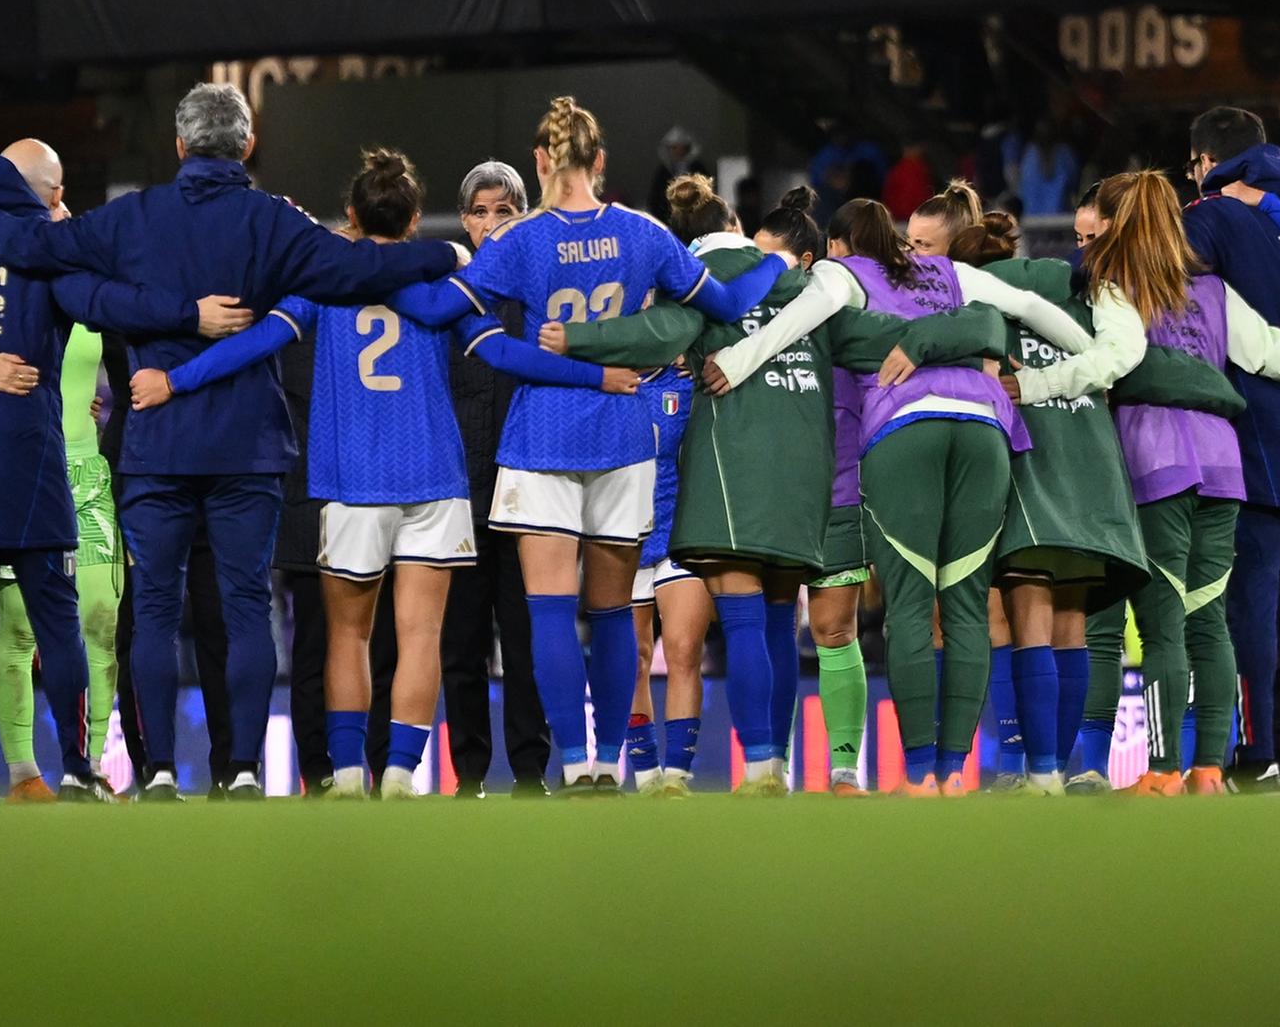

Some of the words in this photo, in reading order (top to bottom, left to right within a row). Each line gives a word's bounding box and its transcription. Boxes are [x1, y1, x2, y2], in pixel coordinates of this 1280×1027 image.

[355, 304, 402, 392] 2
[1000, 718, 1018, 726] ITAL
[1117, 705, 1146, 743] SA
